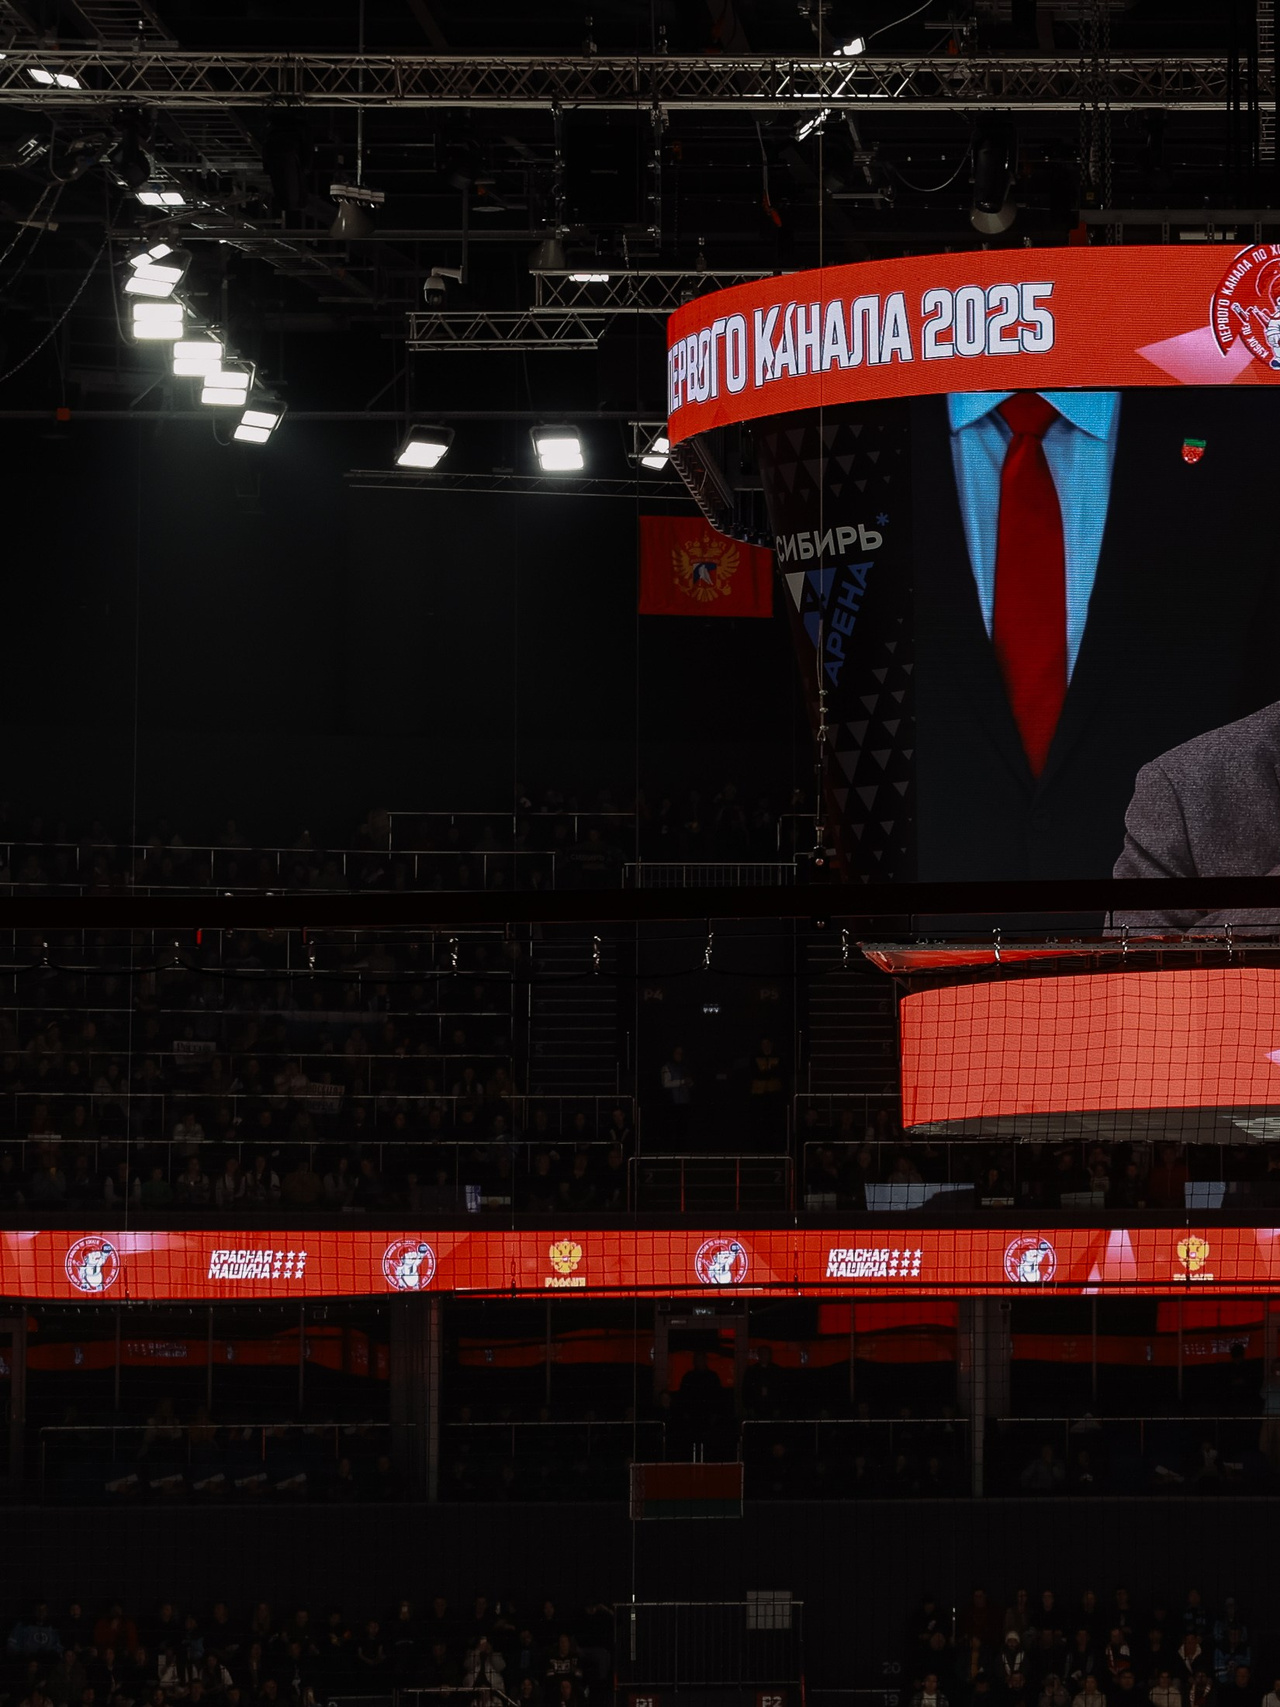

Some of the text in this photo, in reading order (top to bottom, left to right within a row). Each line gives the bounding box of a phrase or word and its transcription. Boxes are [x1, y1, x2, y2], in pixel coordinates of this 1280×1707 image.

[1221, 259, 1253, 296] КАНАЛА
[1252, 248, 1268, 263] ПО
[753, 292, 914, 389] КАНАЛА
[922, 281, 1055, 361] 2025
[776, 523, 884, 563] СИБИРЬ
[823, 561, 875, 688] АРЕНА
[211, 1250, 274, 1264] КРАСНАЯ
[828, 1249, 890, 1262] КРАСНАЯ
[208, 1264, 270, 1279] МАШИНА
[825, 1262, 887, 1277] МАШИНА
